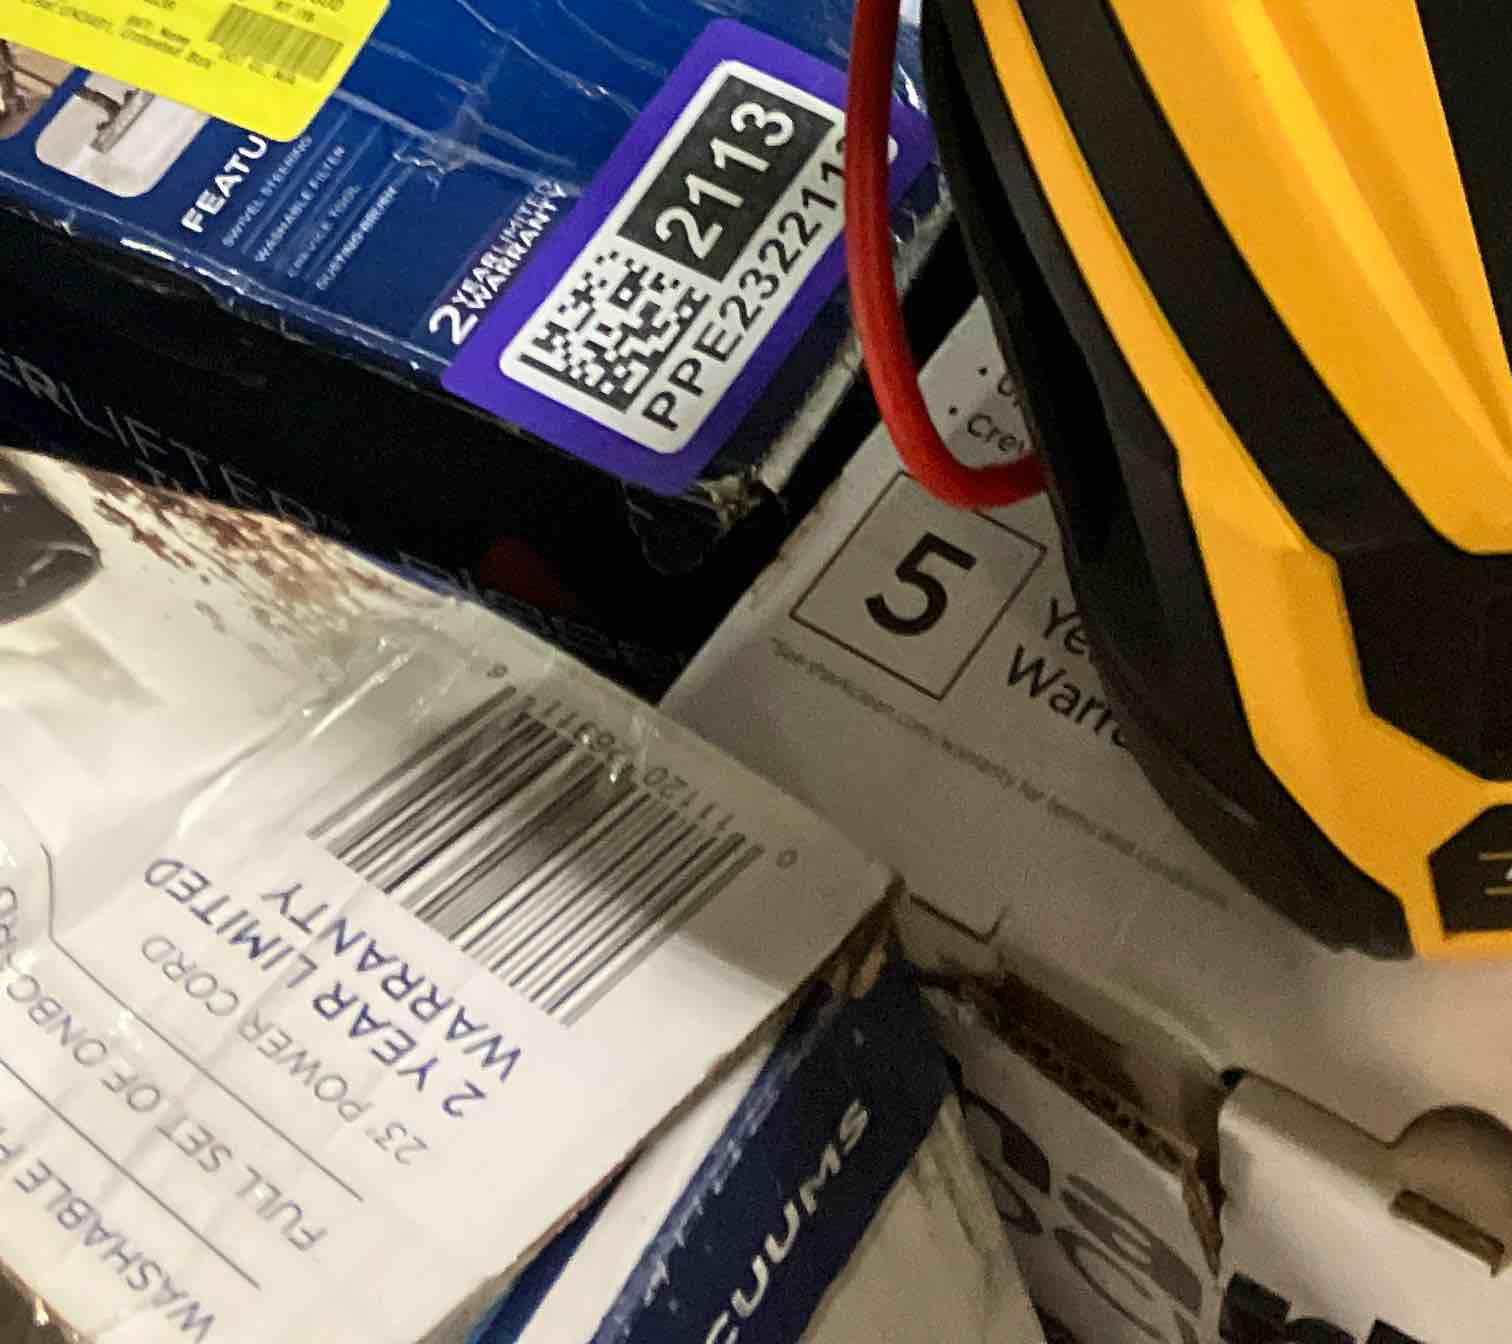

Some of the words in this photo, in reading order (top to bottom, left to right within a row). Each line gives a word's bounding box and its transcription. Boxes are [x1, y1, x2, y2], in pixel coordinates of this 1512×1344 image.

[178, 130, 271, 237] FEATU
[655, 98, 796, 261] 2113
[423, 294, 479, 351] 2
[864, 531, 978, 637] 5
[1006, 645, 1132, 750] Warr
[143, 854, 319, 988] LIMITED
[141, 931, 244, 1021] CORD
[259, 880, 525, 1084] WARRANTY
[236, 1003, 366, 1124] POWER
[312, 978, 436, 1098] YEAR
[104, 1066, 166, 1118] OF
[443, 1079, 490, 1124] 2
[160, 1116, 237, 1180] SET
[14, 1161, 216, 1337] WASHABLE
[234, 1168, 330, 1255] FULL
